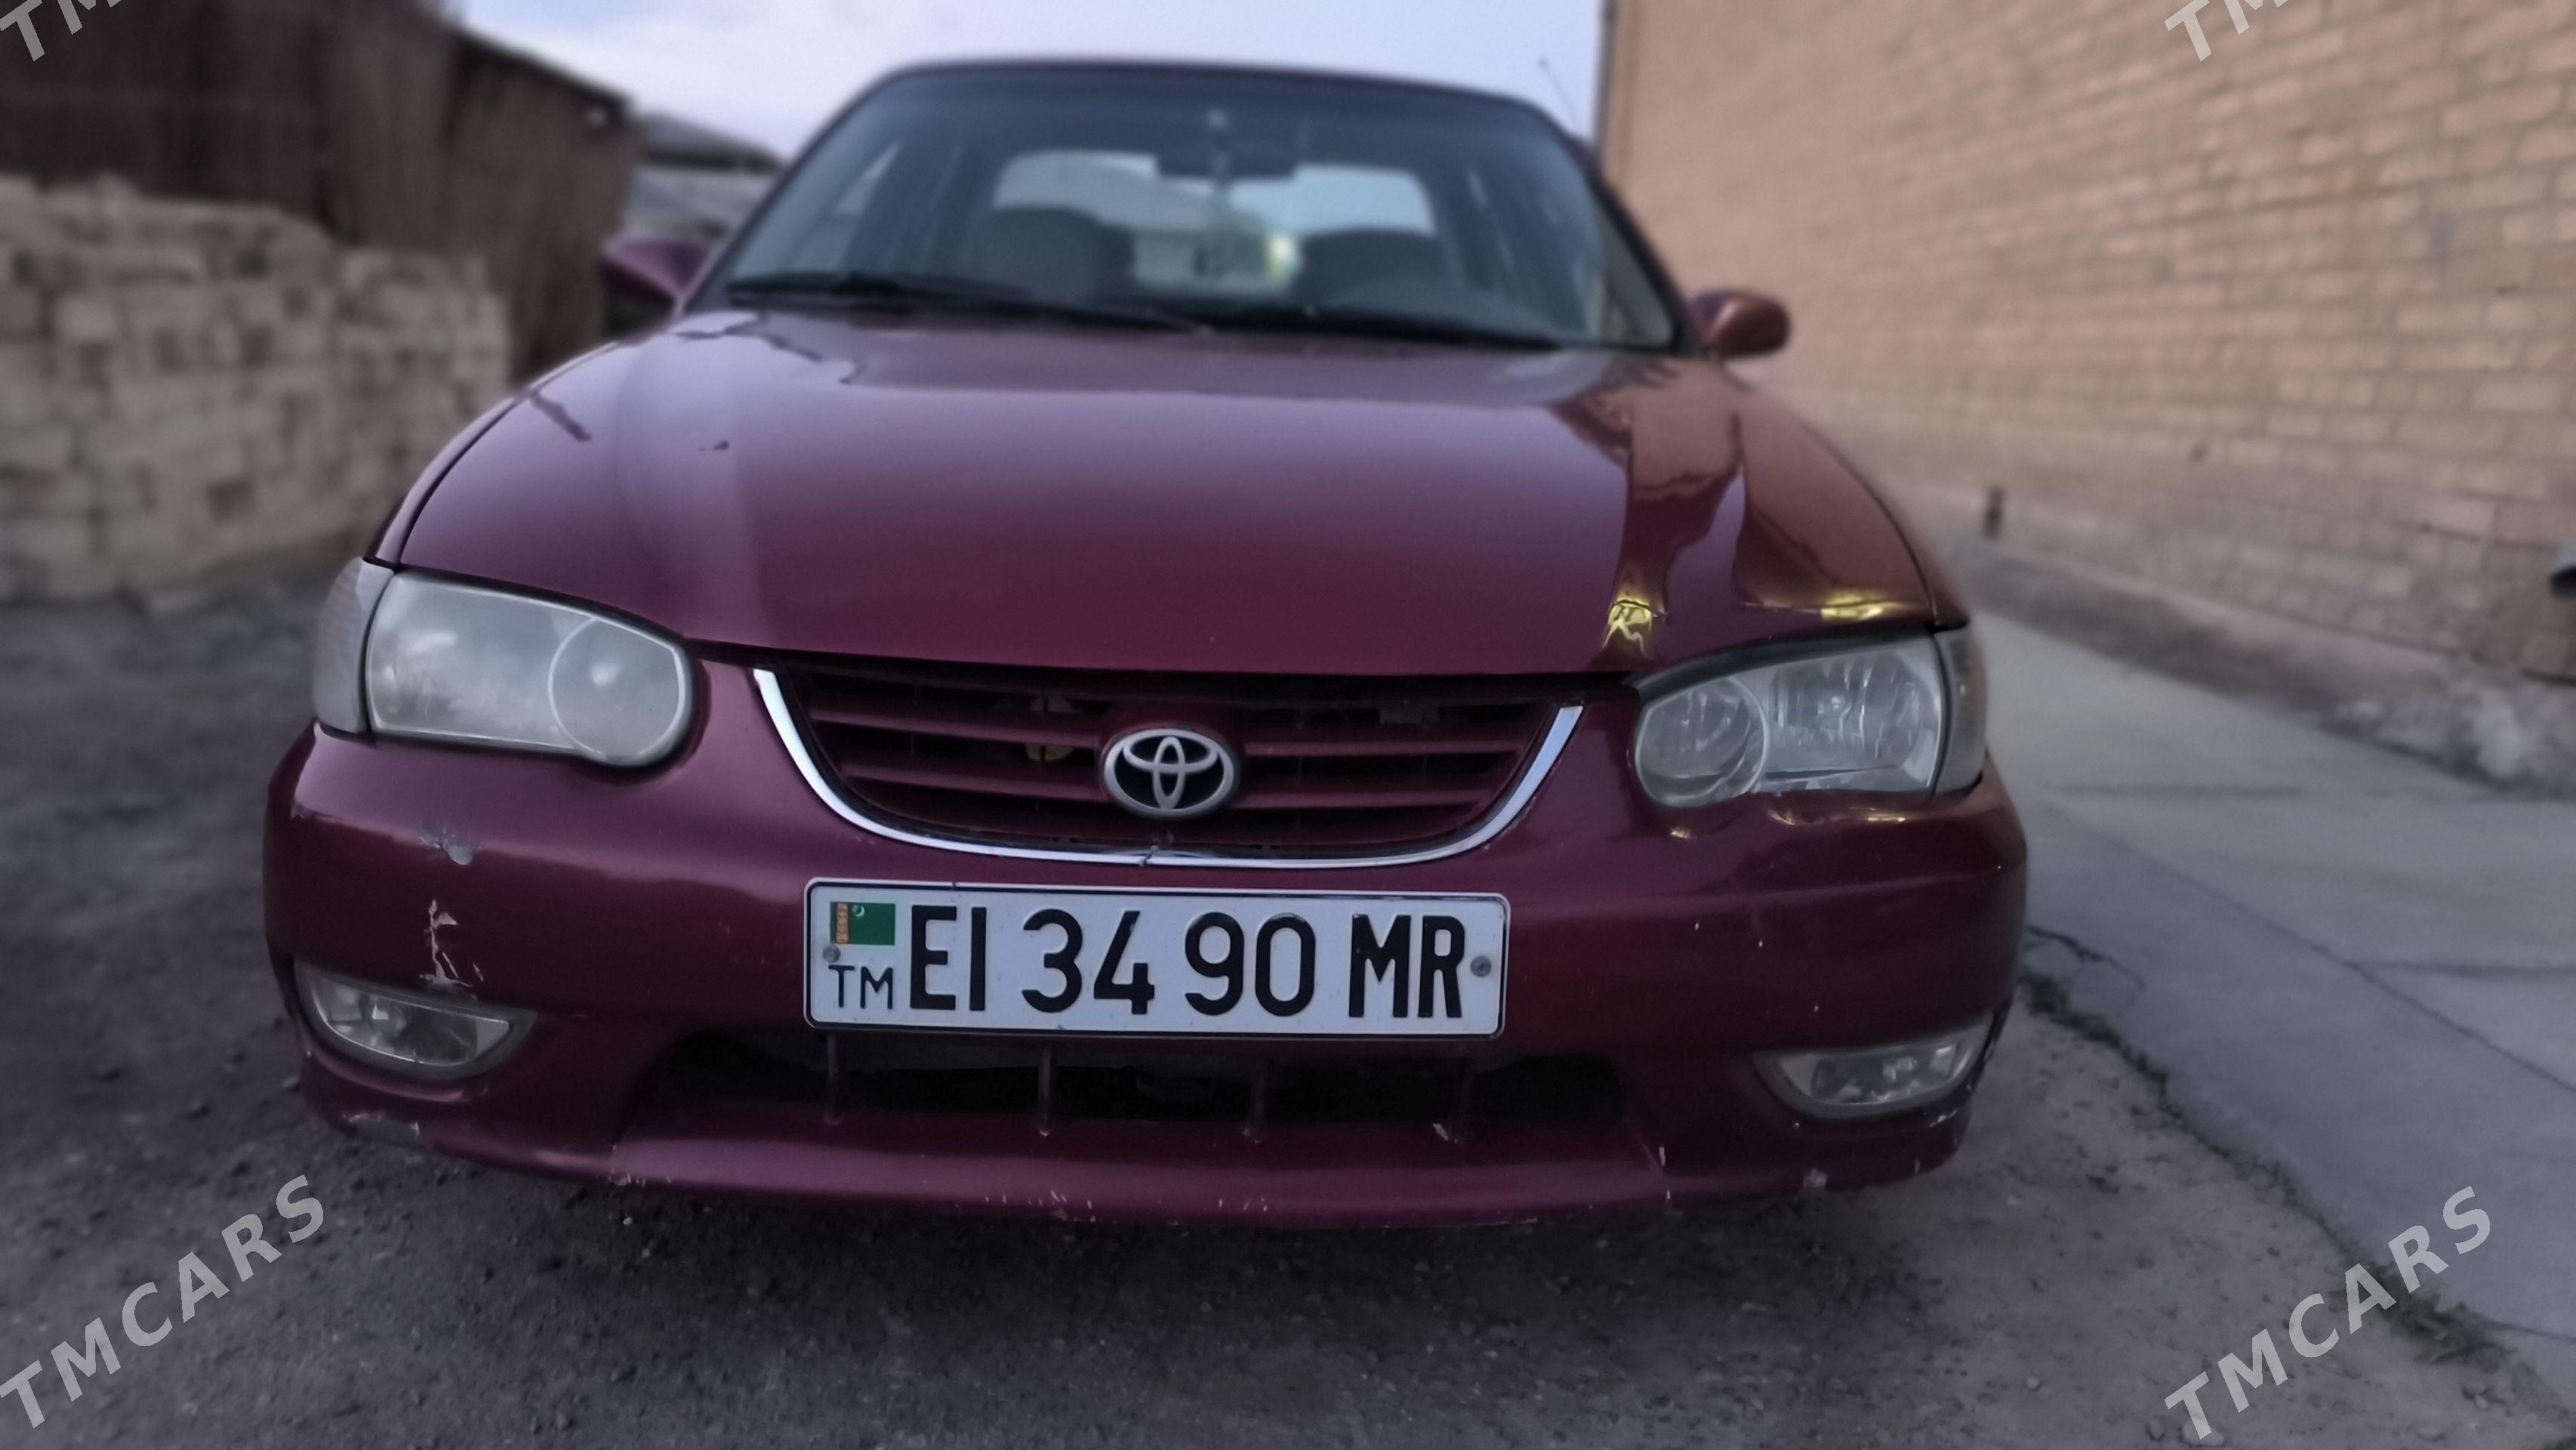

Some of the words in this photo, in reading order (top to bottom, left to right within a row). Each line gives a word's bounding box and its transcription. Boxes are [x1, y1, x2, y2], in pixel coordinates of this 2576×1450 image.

[827, 964, 894, 1010] TM
[909, 904, 988, 1012] EI
[1021, 909, 1155, 1016] 34
[1185, 912, 1317, 1017] 90
[1348, 914, 1466, 1019] MR
